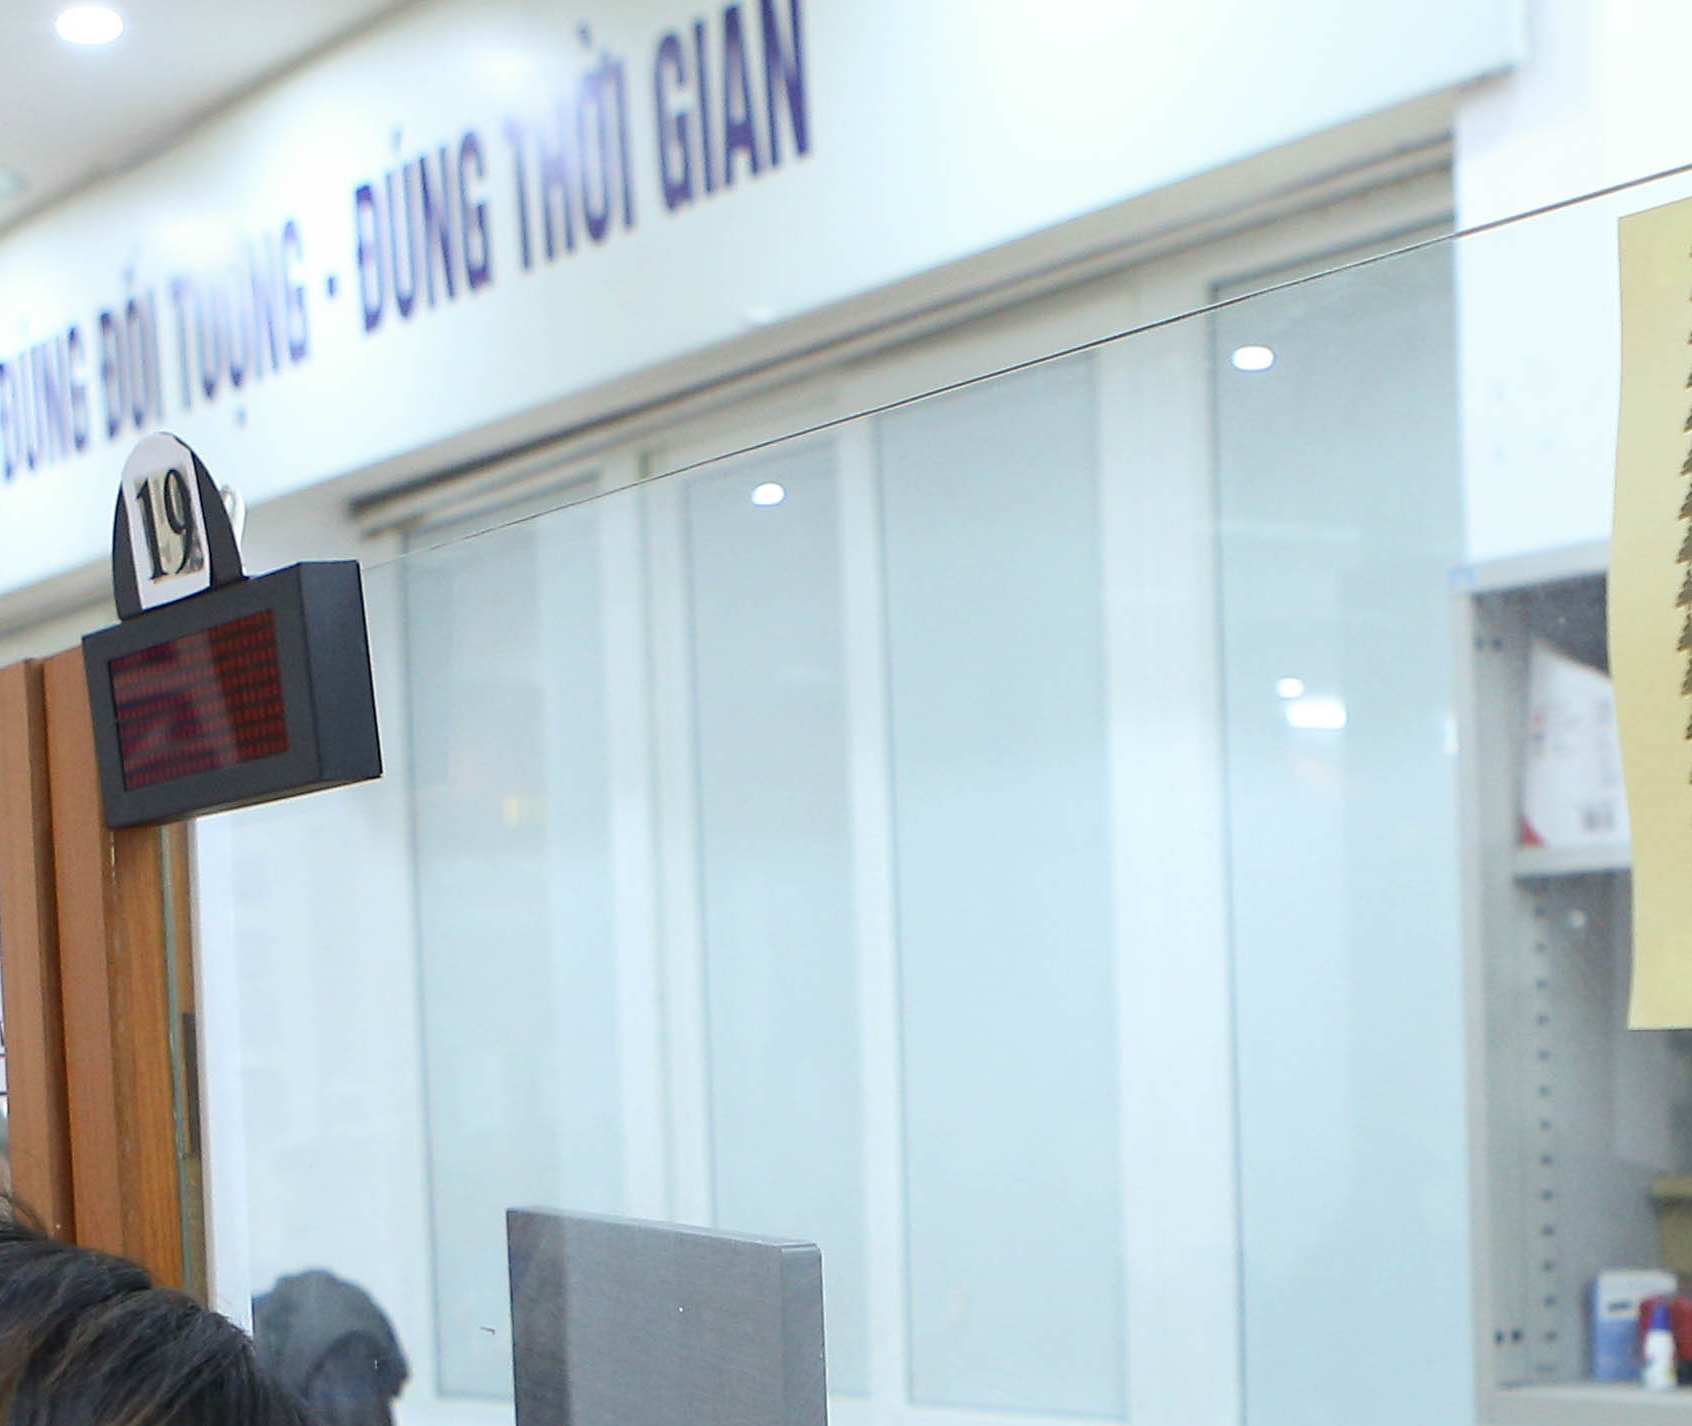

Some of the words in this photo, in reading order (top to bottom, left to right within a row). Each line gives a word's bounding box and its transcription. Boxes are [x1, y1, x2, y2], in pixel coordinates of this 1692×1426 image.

[354, 127, 493, 337] ĐÚNG
[503, 22, 637, 272] THỜI
[654, 0, 812, 213] GIAN
[134, 466, 198, 582] 19
